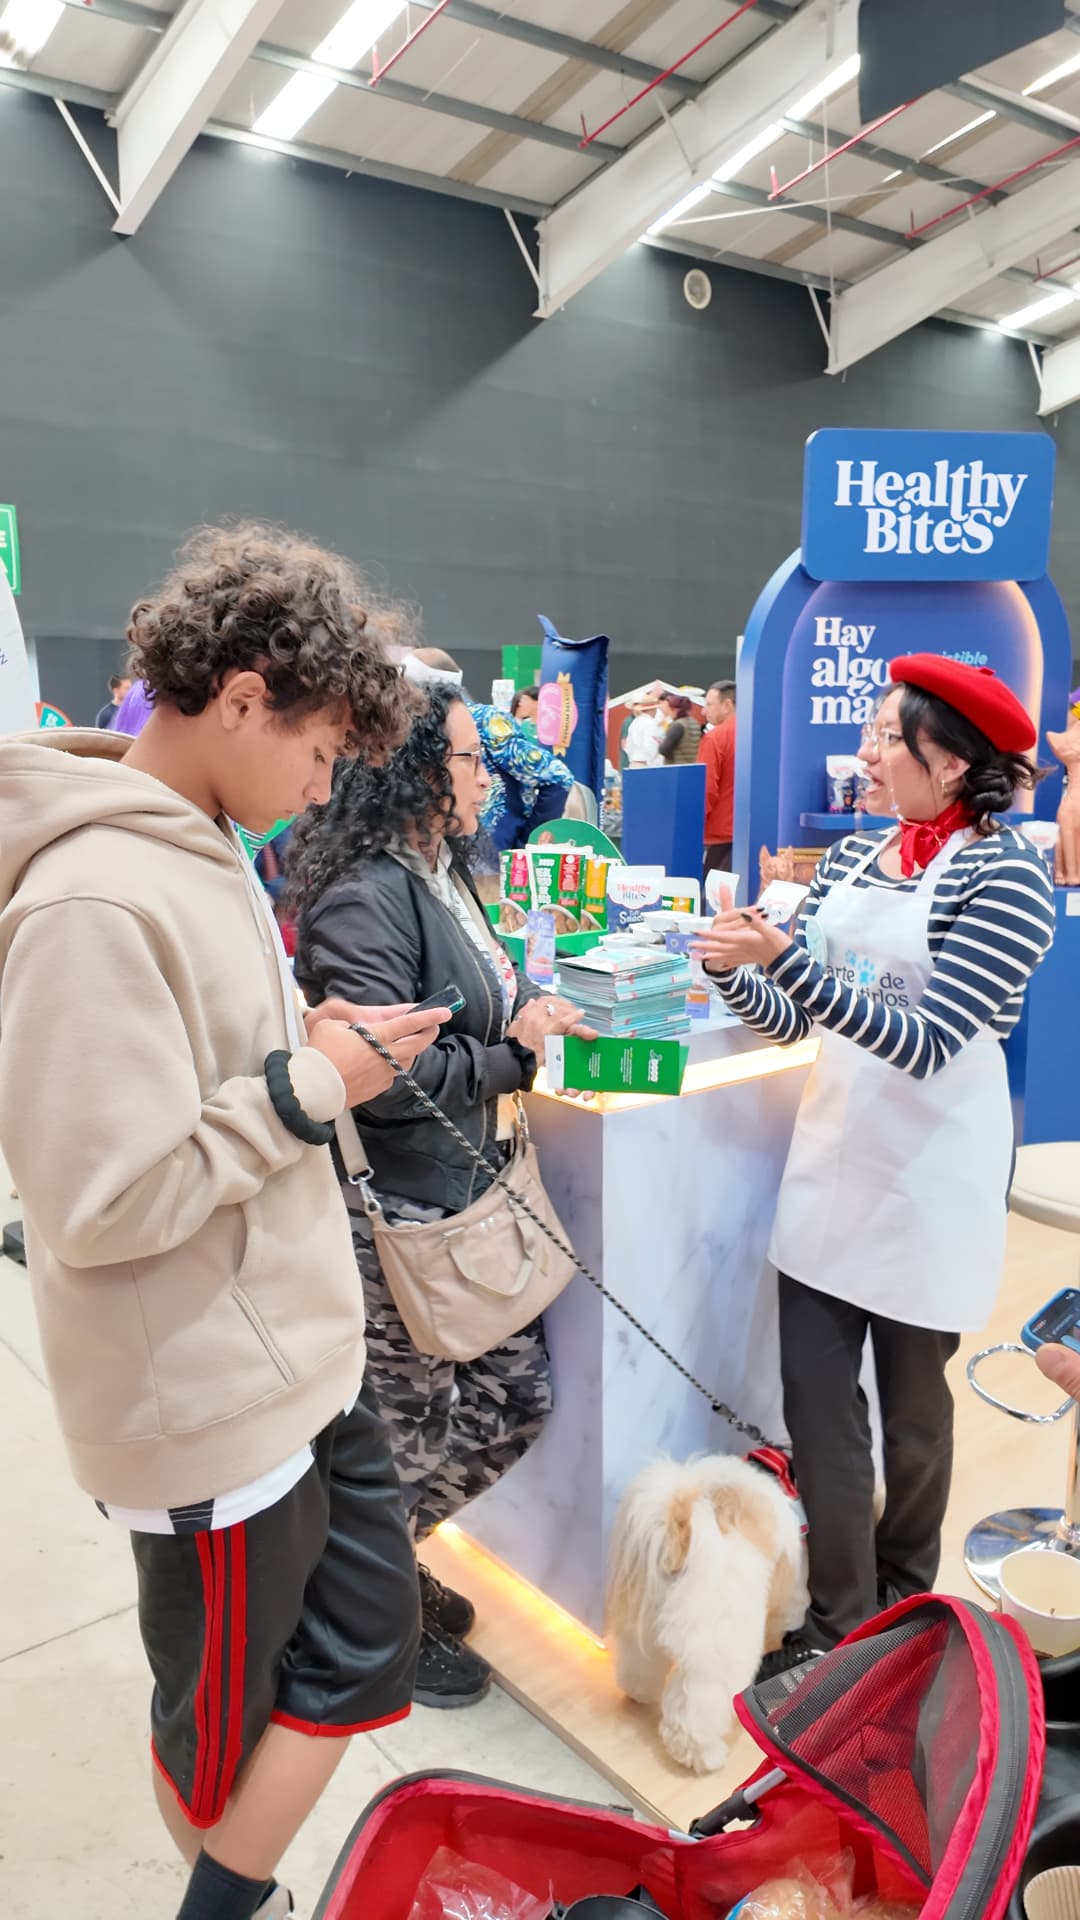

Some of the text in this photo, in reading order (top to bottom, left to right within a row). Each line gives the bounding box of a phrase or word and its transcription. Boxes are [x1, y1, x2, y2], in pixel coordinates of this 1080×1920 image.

[834, 459, 1029, 527] Healthy
[813, 616, 876, 653] Hay
[809, 683, 876, 724] má
[880, 972, 906, 990] de
